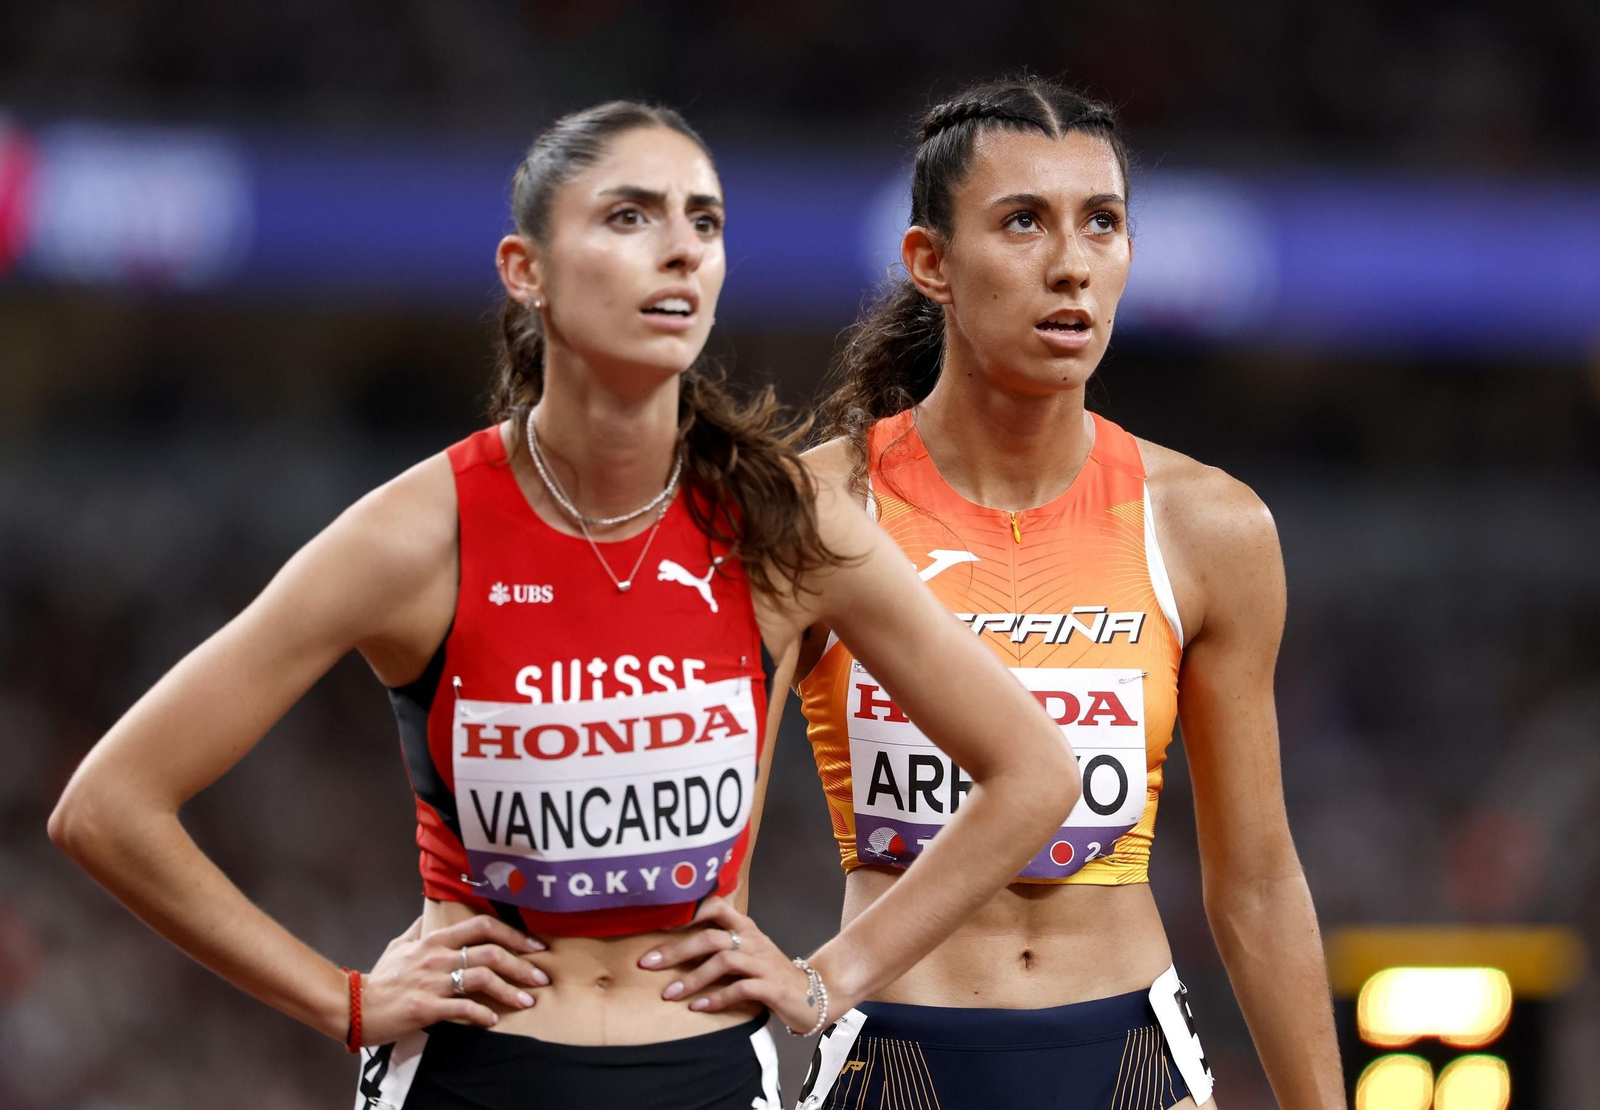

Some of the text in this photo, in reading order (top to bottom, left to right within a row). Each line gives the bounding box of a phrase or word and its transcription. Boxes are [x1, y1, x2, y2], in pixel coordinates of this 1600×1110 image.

[513, 584, 554, 604] UBS
[854, 683, 1139, 727] HDA
[460, 704, 749, 761] HONDA
[469, 767, 743, 851] VANCARDO
